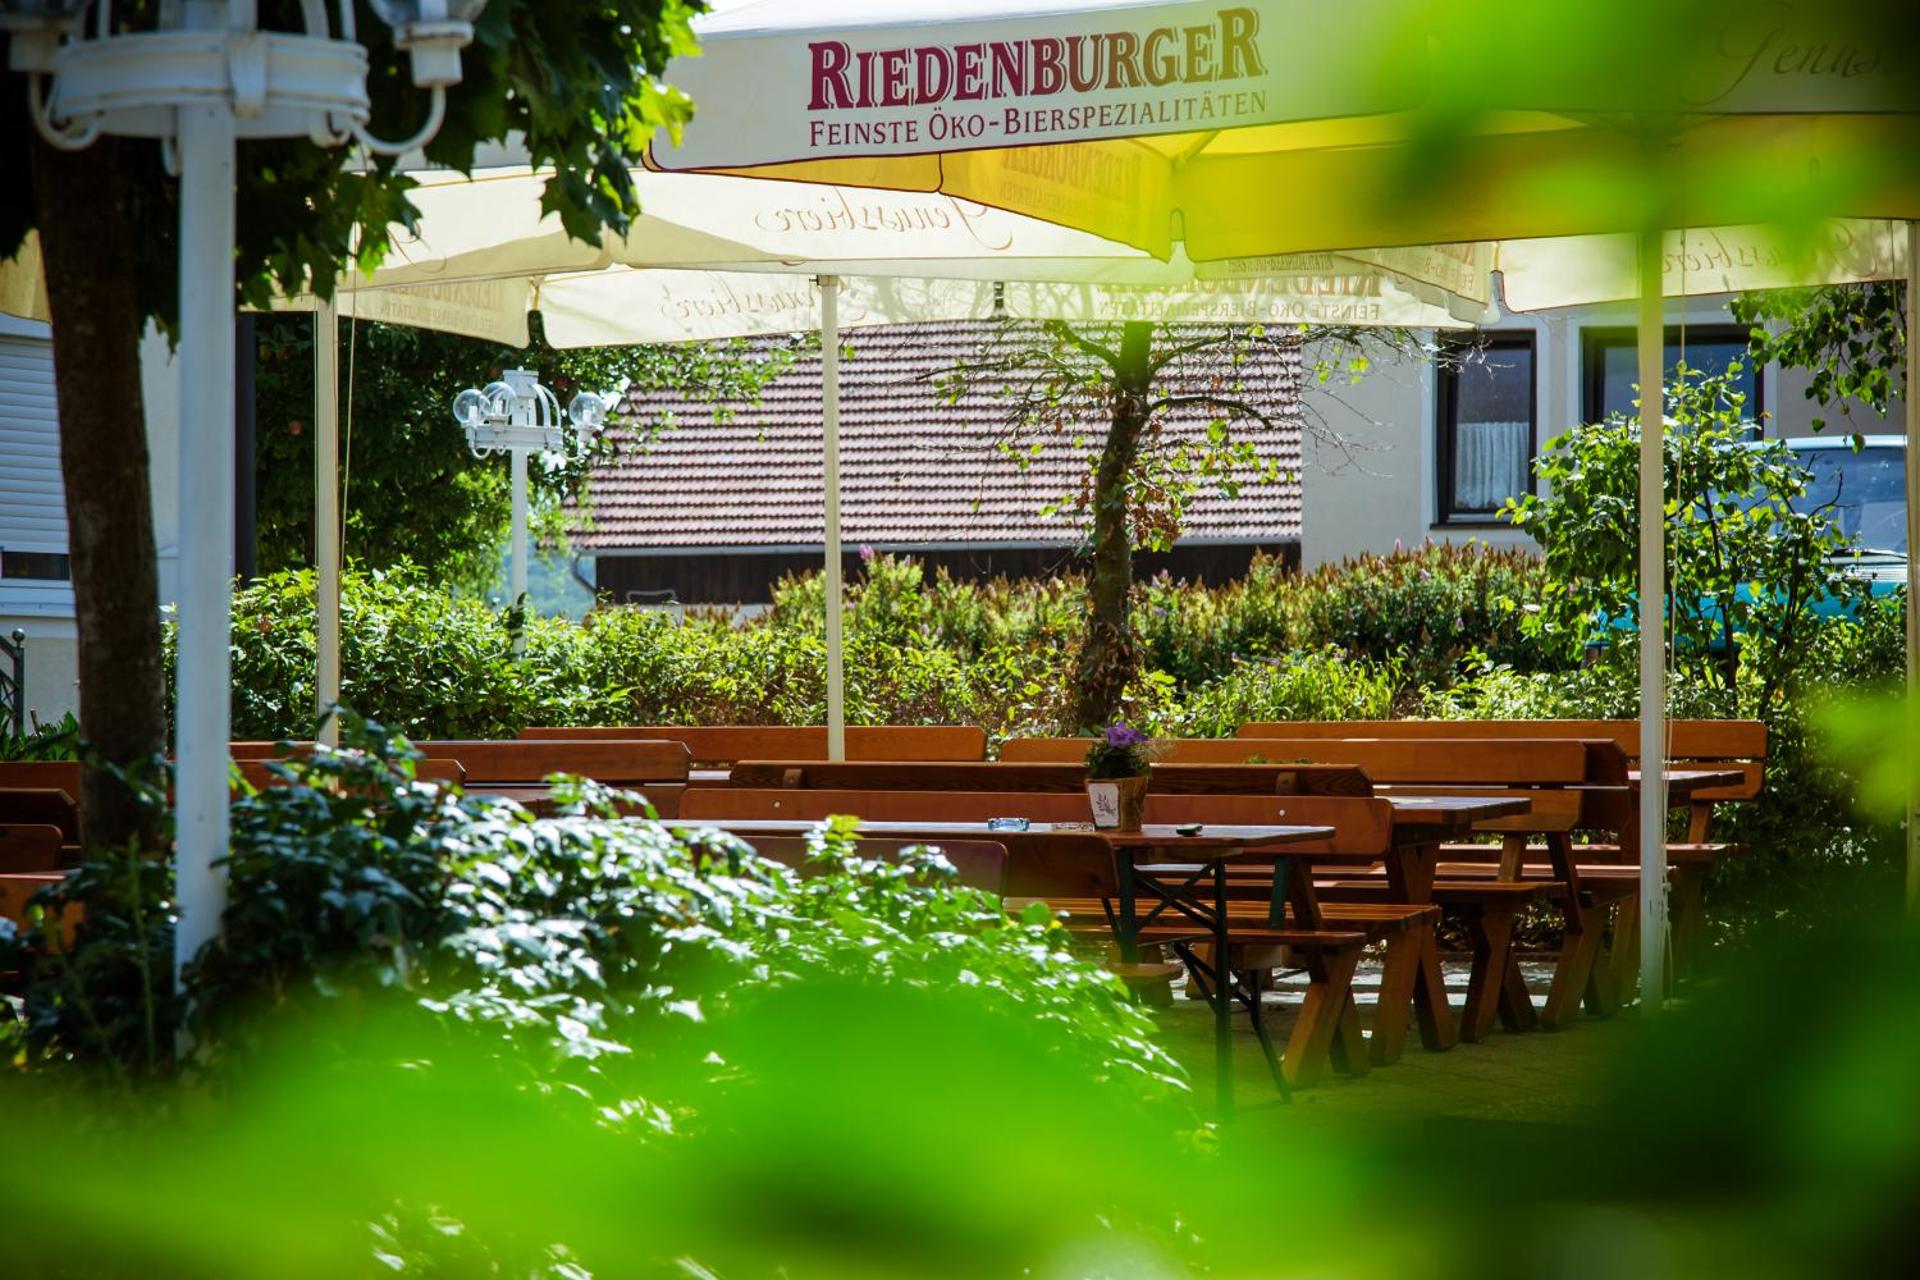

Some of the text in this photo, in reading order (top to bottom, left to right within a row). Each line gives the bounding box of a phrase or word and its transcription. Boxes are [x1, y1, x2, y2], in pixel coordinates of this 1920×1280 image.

[807, 6, 1267, 111] RIEDENBURGER
[810, 90, 1267, 147] FEINSTE ÖKO-BIERSPEZIALITÄTEN
